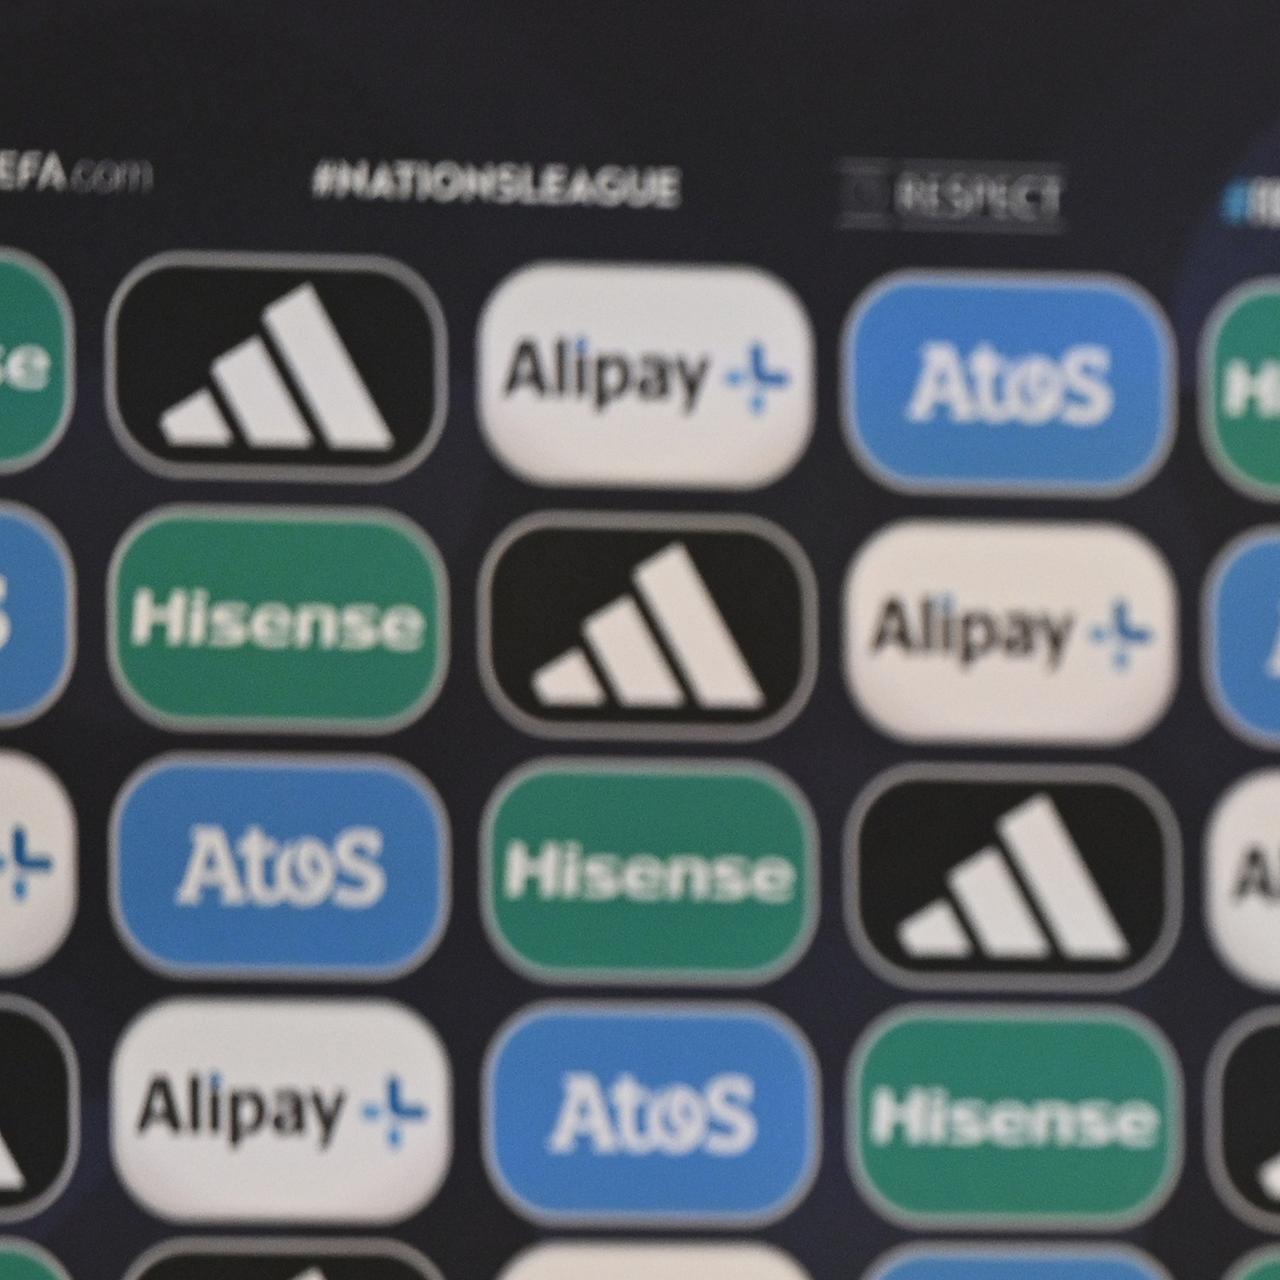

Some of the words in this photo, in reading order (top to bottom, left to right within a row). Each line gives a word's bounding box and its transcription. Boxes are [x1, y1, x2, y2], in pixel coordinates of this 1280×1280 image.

[312, 160, 679, 209] #NATIONSLEAGUE
[131, 588, 424, 651] Hisense
[505, 841, 795, 903] Hisense
[870, 1086, 1159, 1148] Hisense
